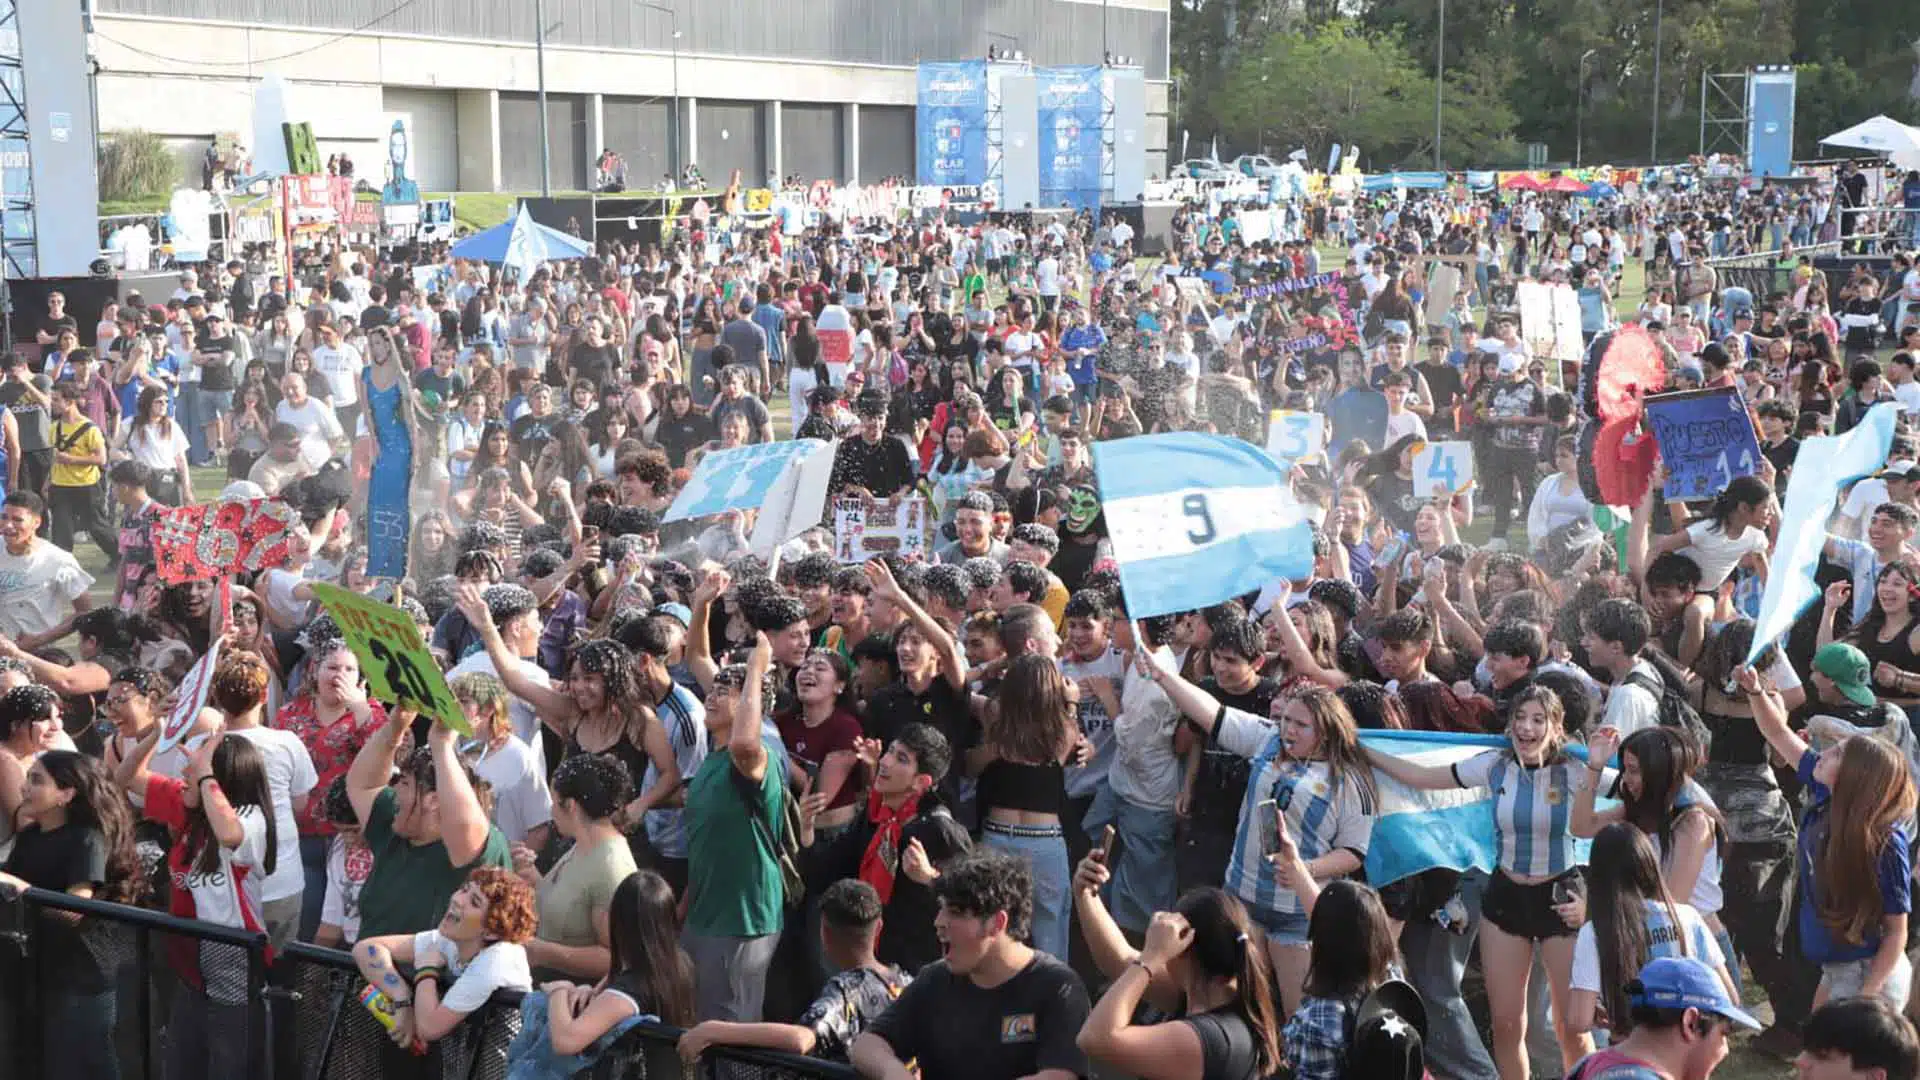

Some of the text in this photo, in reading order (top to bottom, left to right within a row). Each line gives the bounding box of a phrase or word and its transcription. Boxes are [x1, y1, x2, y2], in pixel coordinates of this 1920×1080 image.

[1281, 416, 1311, 457] 3
[1427, 446, 1456, 492] 4
[373, 510, 403, 540] 53
[1183, 493, 1217, 545] 9
[368, 637, 437, 710] 20
